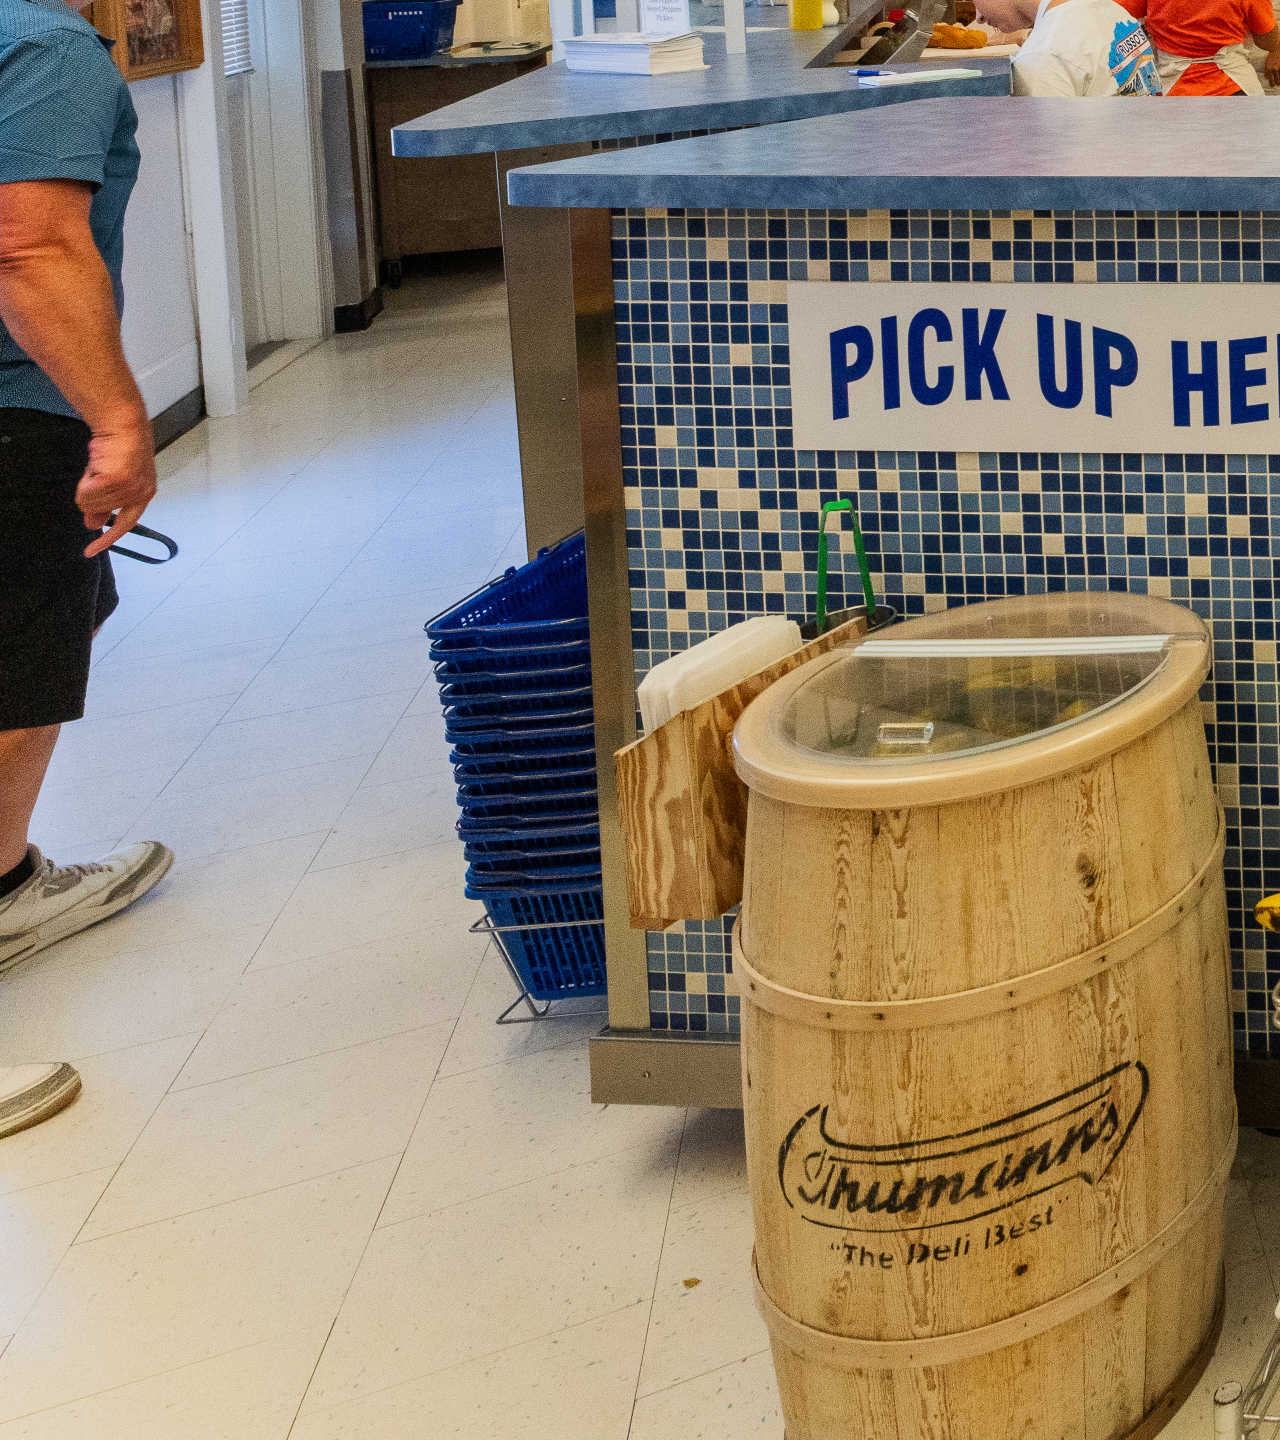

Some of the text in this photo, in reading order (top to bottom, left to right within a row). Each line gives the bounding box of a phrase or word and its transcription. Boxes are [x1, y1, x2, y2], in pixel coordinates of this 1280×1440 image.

[829, 306, 1011, 421] PICK
[1036, 312, 1138, 419] UP
[829, 1196, 1070, 1269] "The Deli Best"
